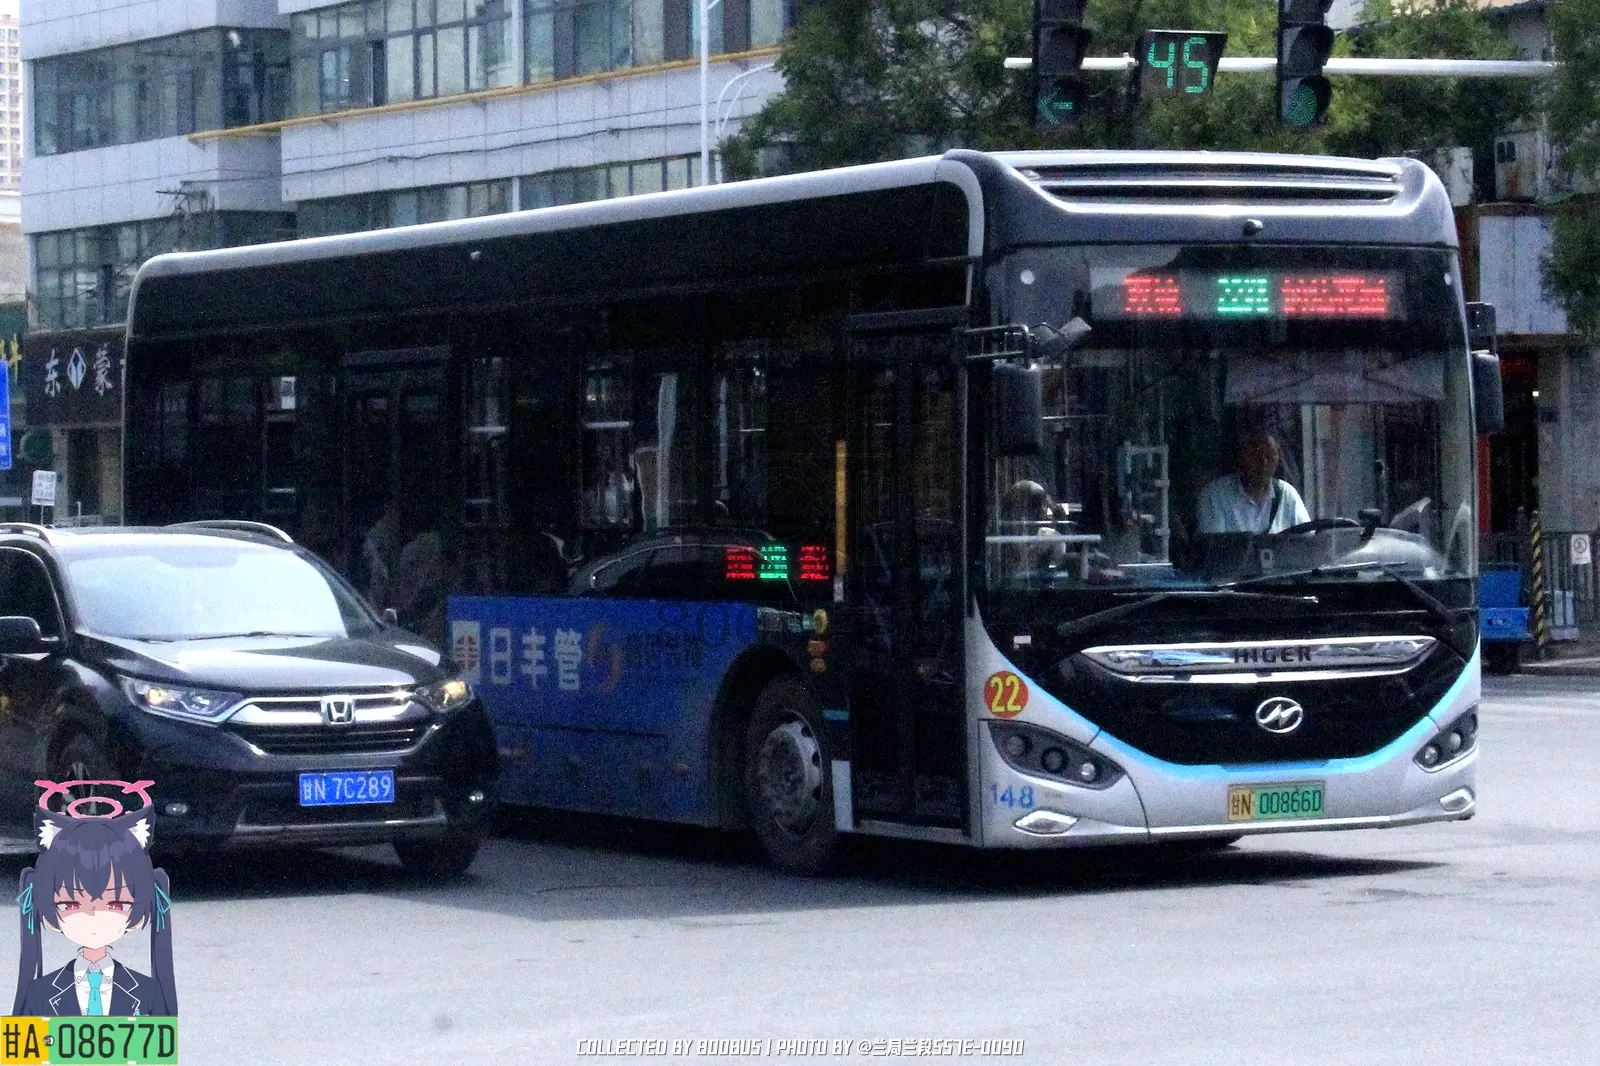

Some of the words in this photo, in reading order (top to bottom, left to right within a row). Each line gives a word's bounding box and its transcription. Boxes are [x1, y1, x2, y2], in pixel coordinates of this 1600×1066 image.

[1148, 37, 1208, 93] 45
[1234, 646, 1312, 663] HIGER
[991, 675, 1022, 713] 22
[990, 783, 1034, 809] 148
